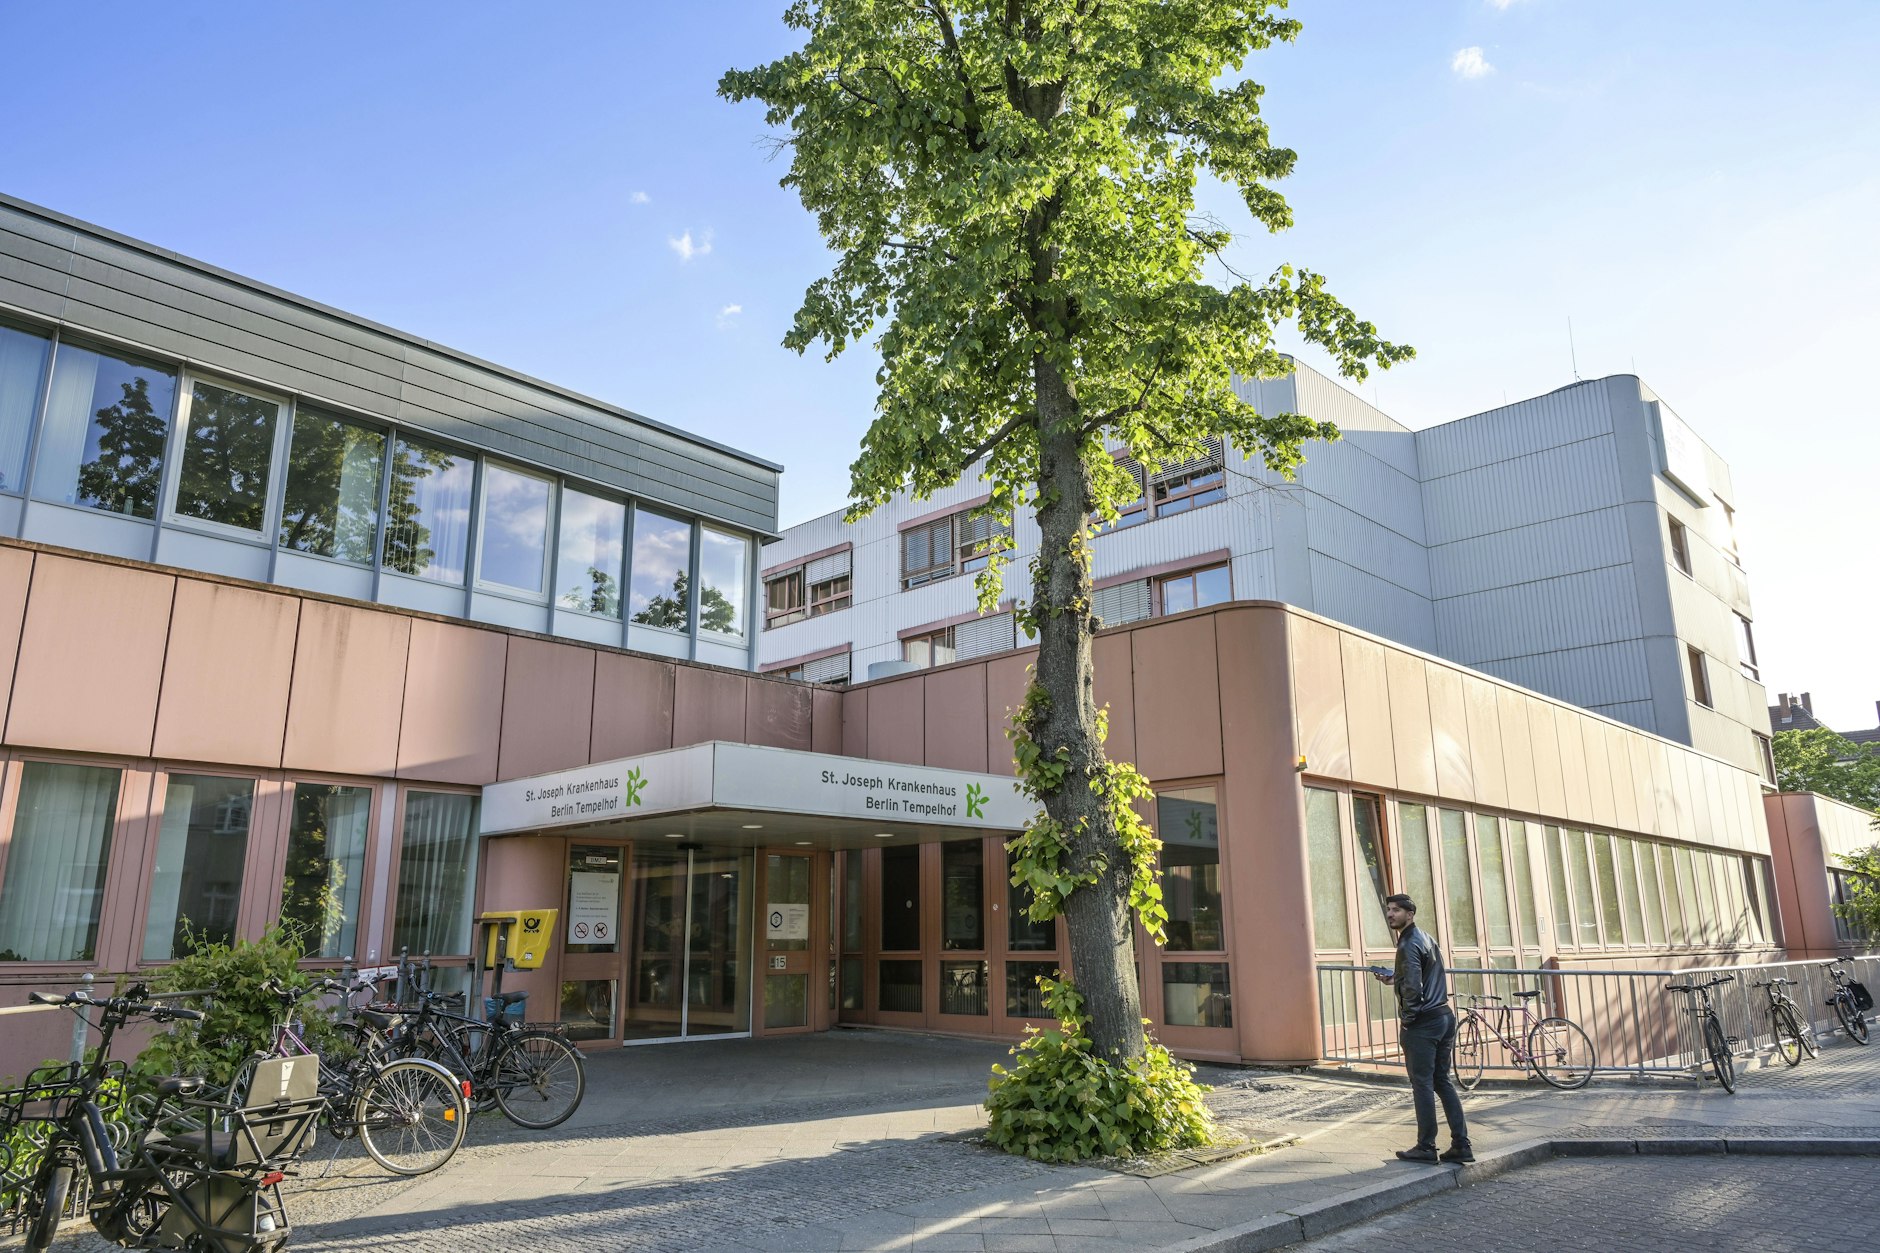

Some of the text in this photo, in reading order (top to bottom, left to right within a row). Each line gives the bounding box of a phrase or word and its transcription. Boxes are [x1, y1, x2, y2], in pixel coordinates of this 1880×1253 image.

[525, 777, 619, 802] St. Joseph Krankenhaus
[821, 770, 957, 797] St. Joseph Krankenhaus
[551, 796, 619, 817] Berlin Tempelhof
[866, 796, 957, 817] Berlin Tempelhof
[775, 957, 786, 968] 15
